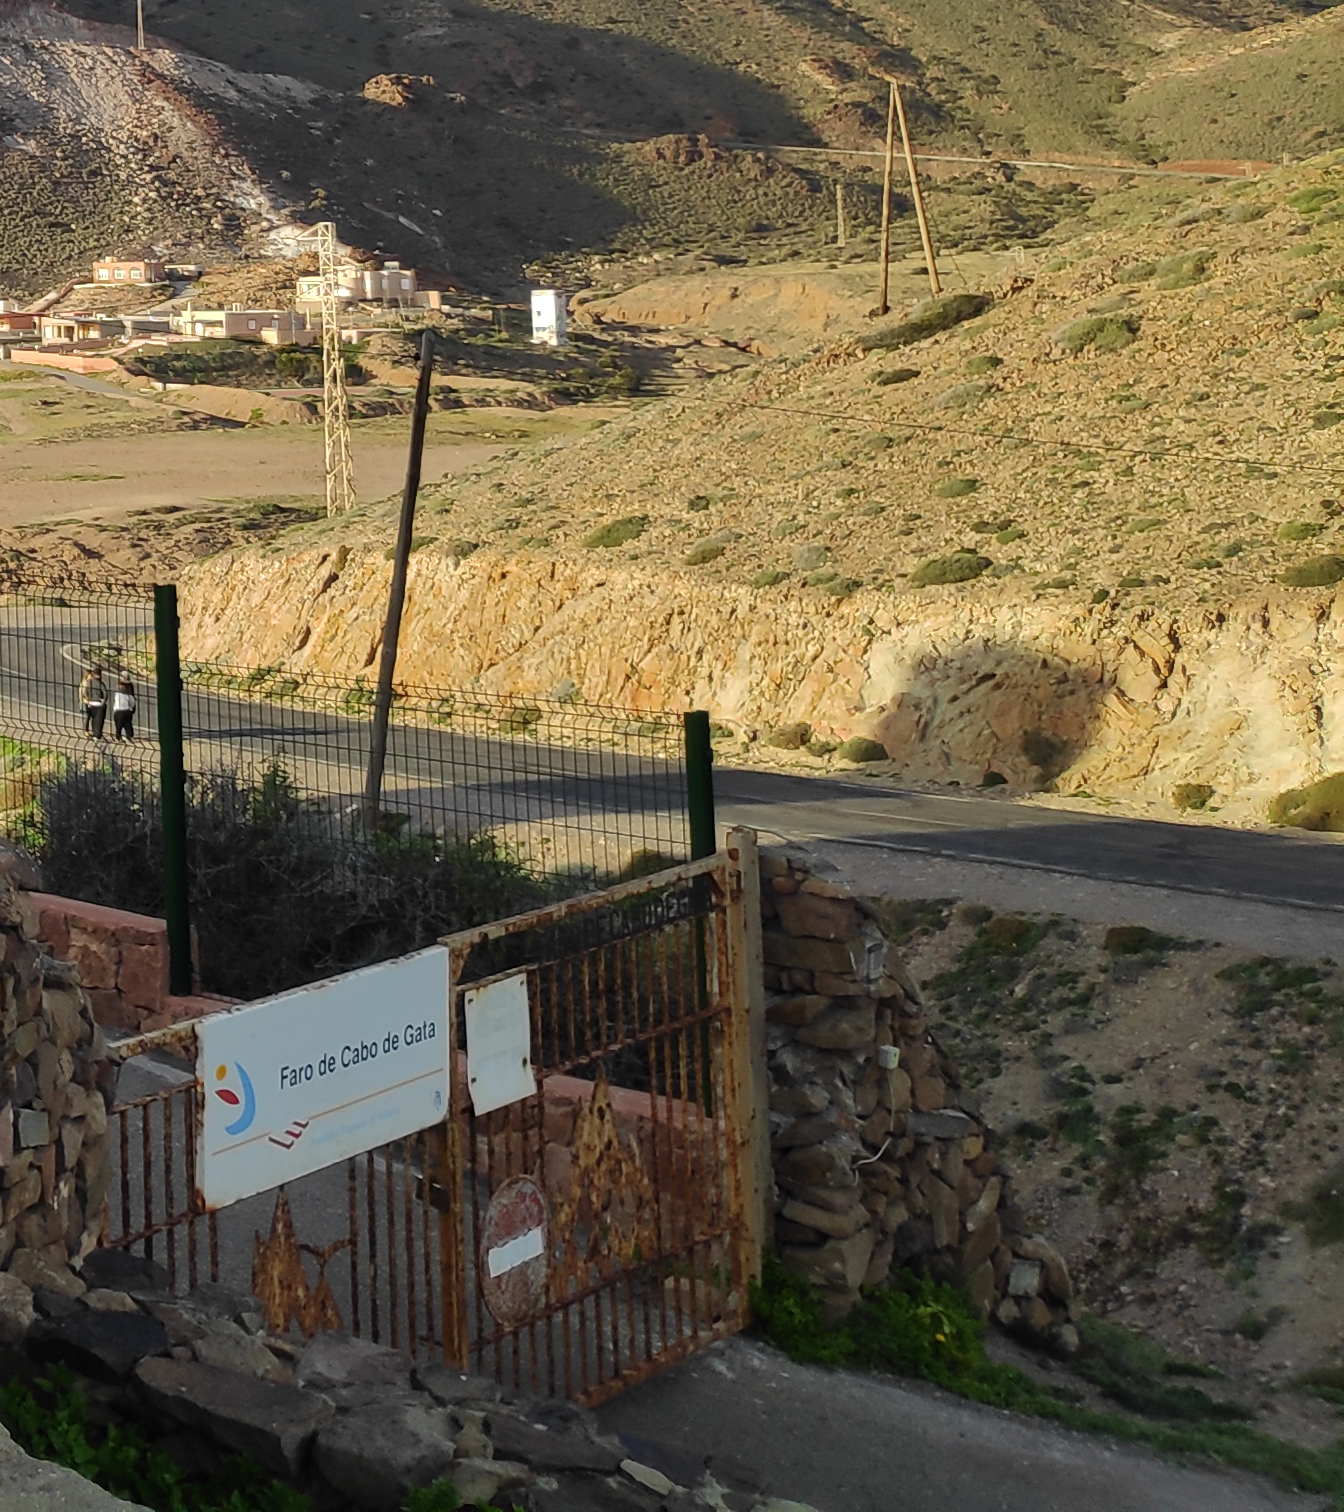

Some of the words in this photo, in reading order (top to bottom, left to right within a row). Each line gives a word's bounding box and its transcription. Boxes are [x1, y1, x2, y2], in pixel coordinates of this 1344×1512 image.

[280, 1063, 314, 1090] Faro
[318, 1052, 336, 1077] de
[340, 1039, 379, 1068] Cabo
[382, 1030, 400, 1055] de
[403, 1020, 436, 1047] Gata
